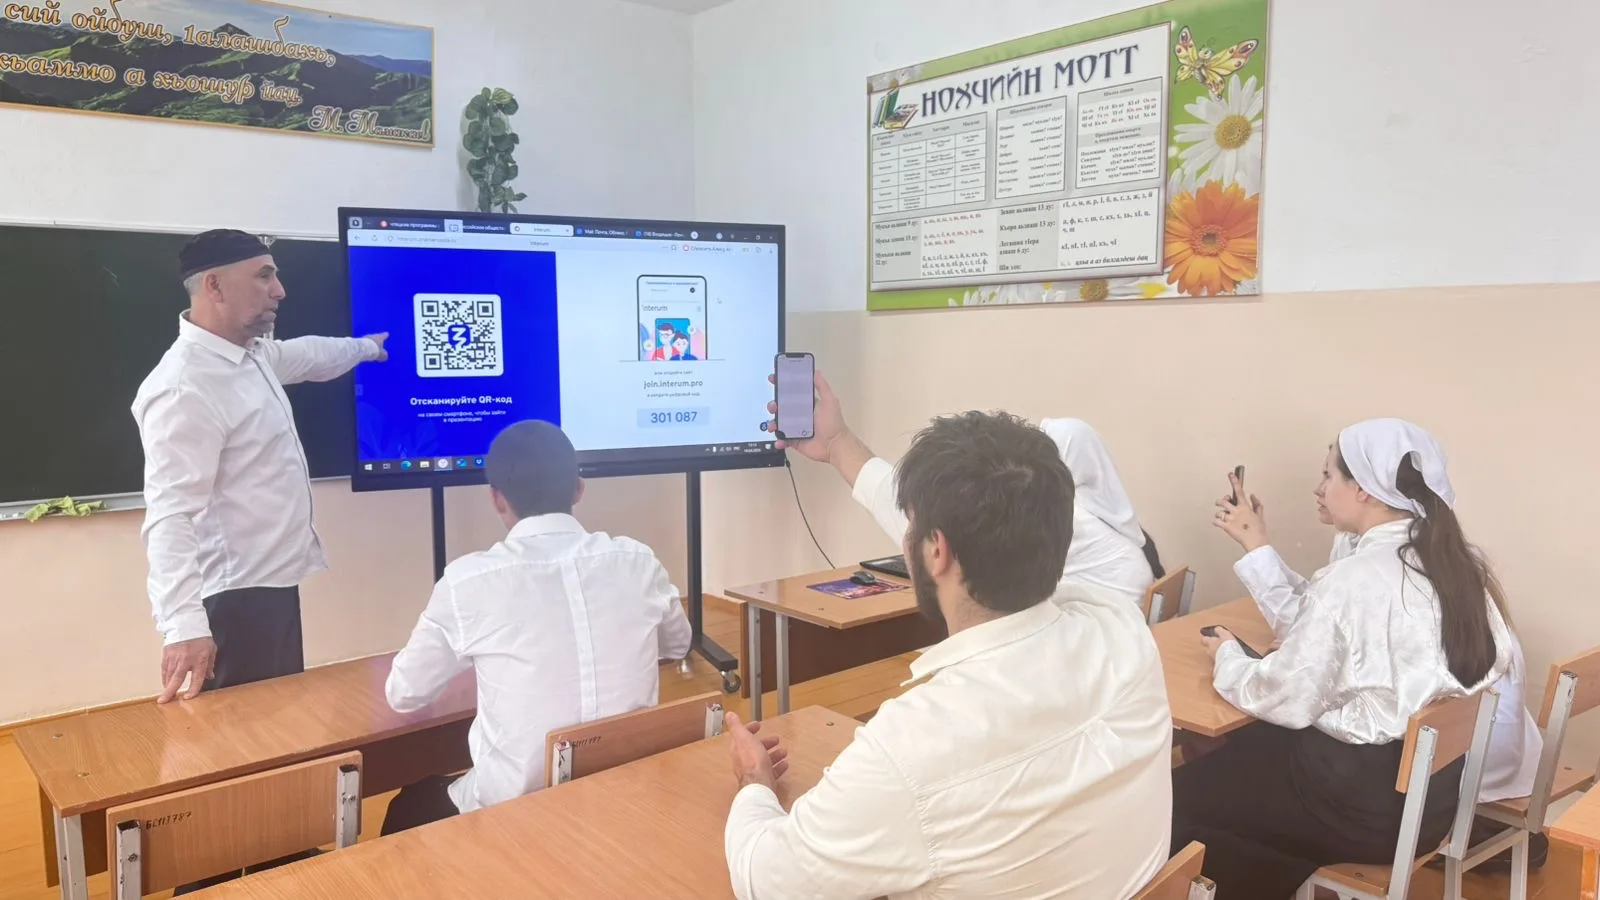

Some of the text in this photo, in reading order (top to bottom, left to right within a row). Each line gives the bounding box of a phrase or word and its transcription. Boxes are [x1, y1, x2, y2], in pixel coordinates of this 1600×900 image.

[5, 1, 61, 25] сий
[72, 0, 172, 44] ойбуш,
[125, 68, 145, 86] а
[153, 72, 255, 104] хьошур
[921, 65, 1041, 117] НОХЧИЙН
[1054, 44, 1138, 89] МОТТ
[643, 380, 704, 390] join.interum.pro
[410, 395, 513, 406] Отсканируйте QR-код
[650, 411, 698, 424] 301 087
